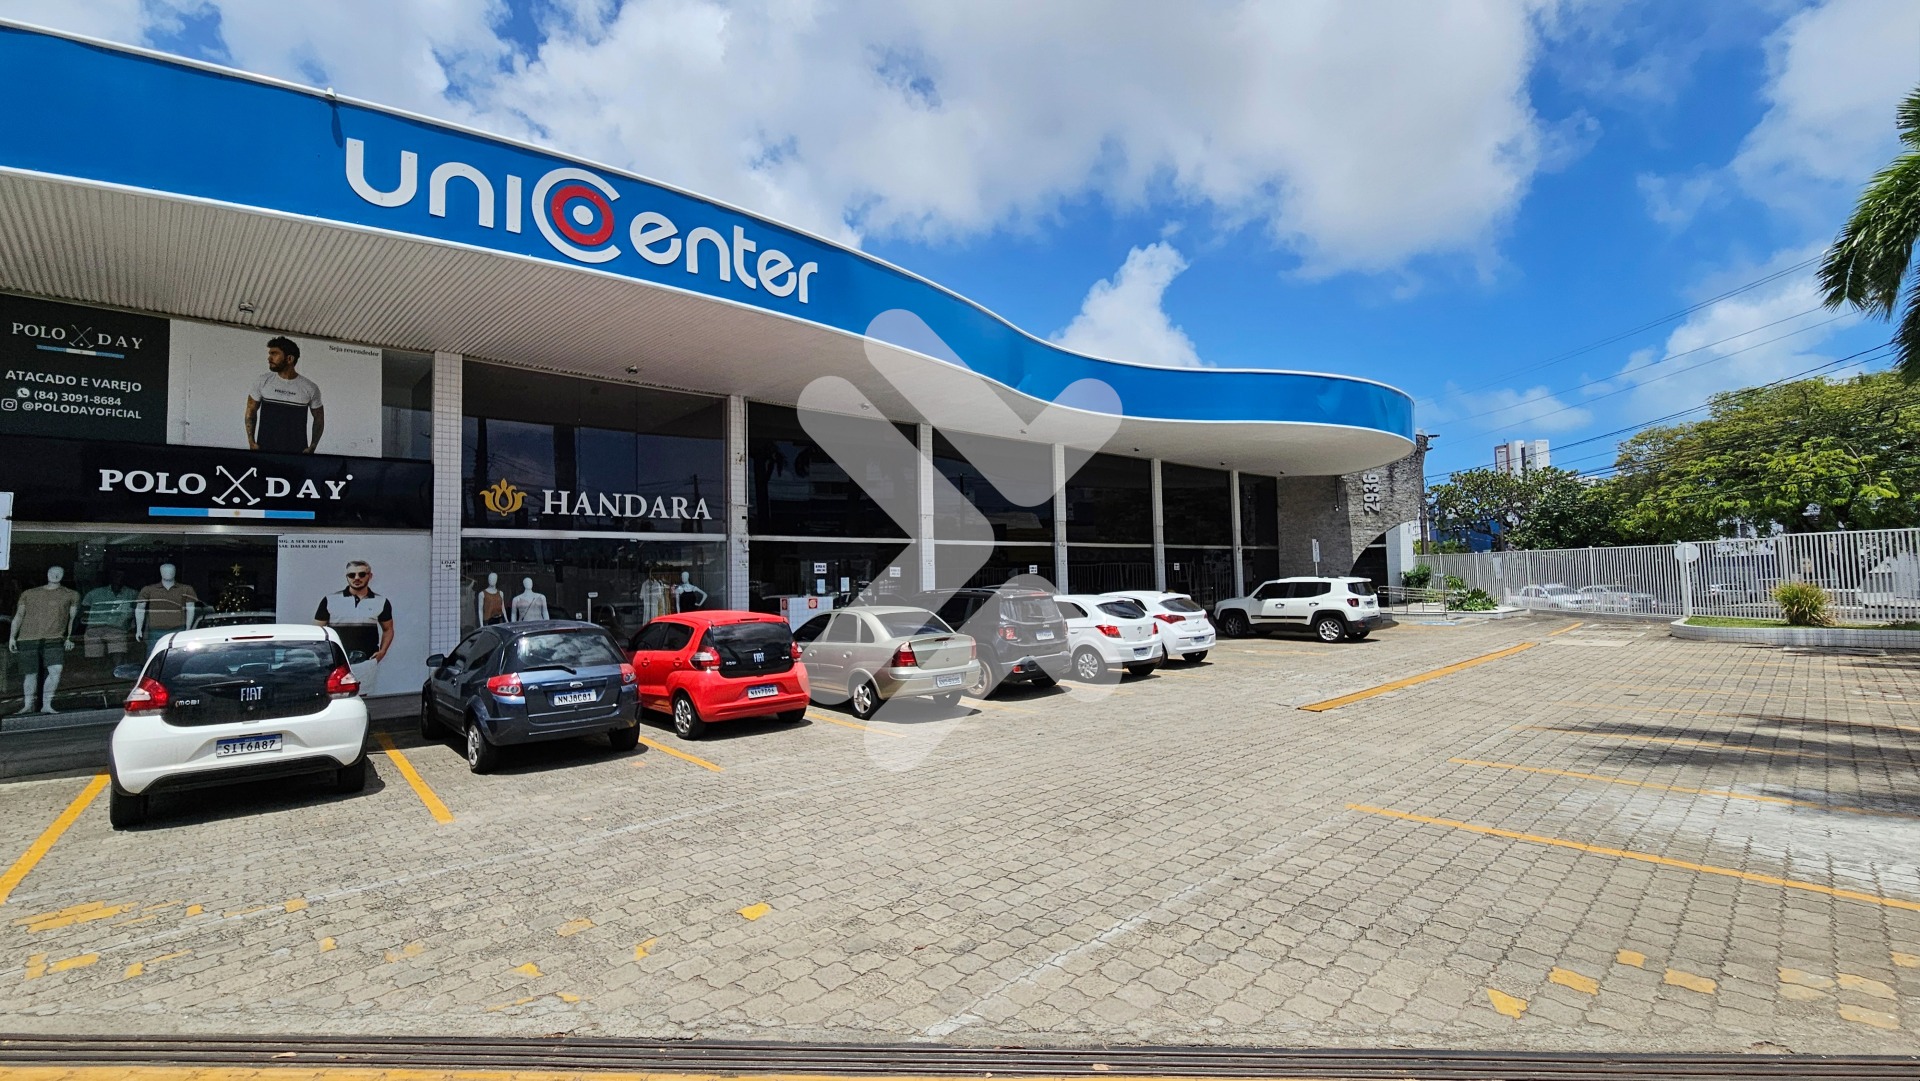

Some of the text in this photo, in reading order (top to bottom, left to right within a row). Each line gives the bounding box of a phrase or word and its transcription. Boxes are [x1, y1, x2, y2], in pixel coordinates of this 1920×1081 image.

[12, 322, 143, 350] POLO DAY
[329, 345, 343, 353] Seja
[5, 370, 142, 393] ATACADO E VAREJO
[34, 390, 122, 406] (84) 3091-8684
[22, 401, 142, 419] @POLODAYOFICIAL
[99, 468, 347, 500] POLO DAY
[1362, 473, 1381, 512] 2936
[542, 489, 713, 521] HANDARA
[240, 686, 263, 702] FIAT
[223, 740, 276, 755] SIT6A87
